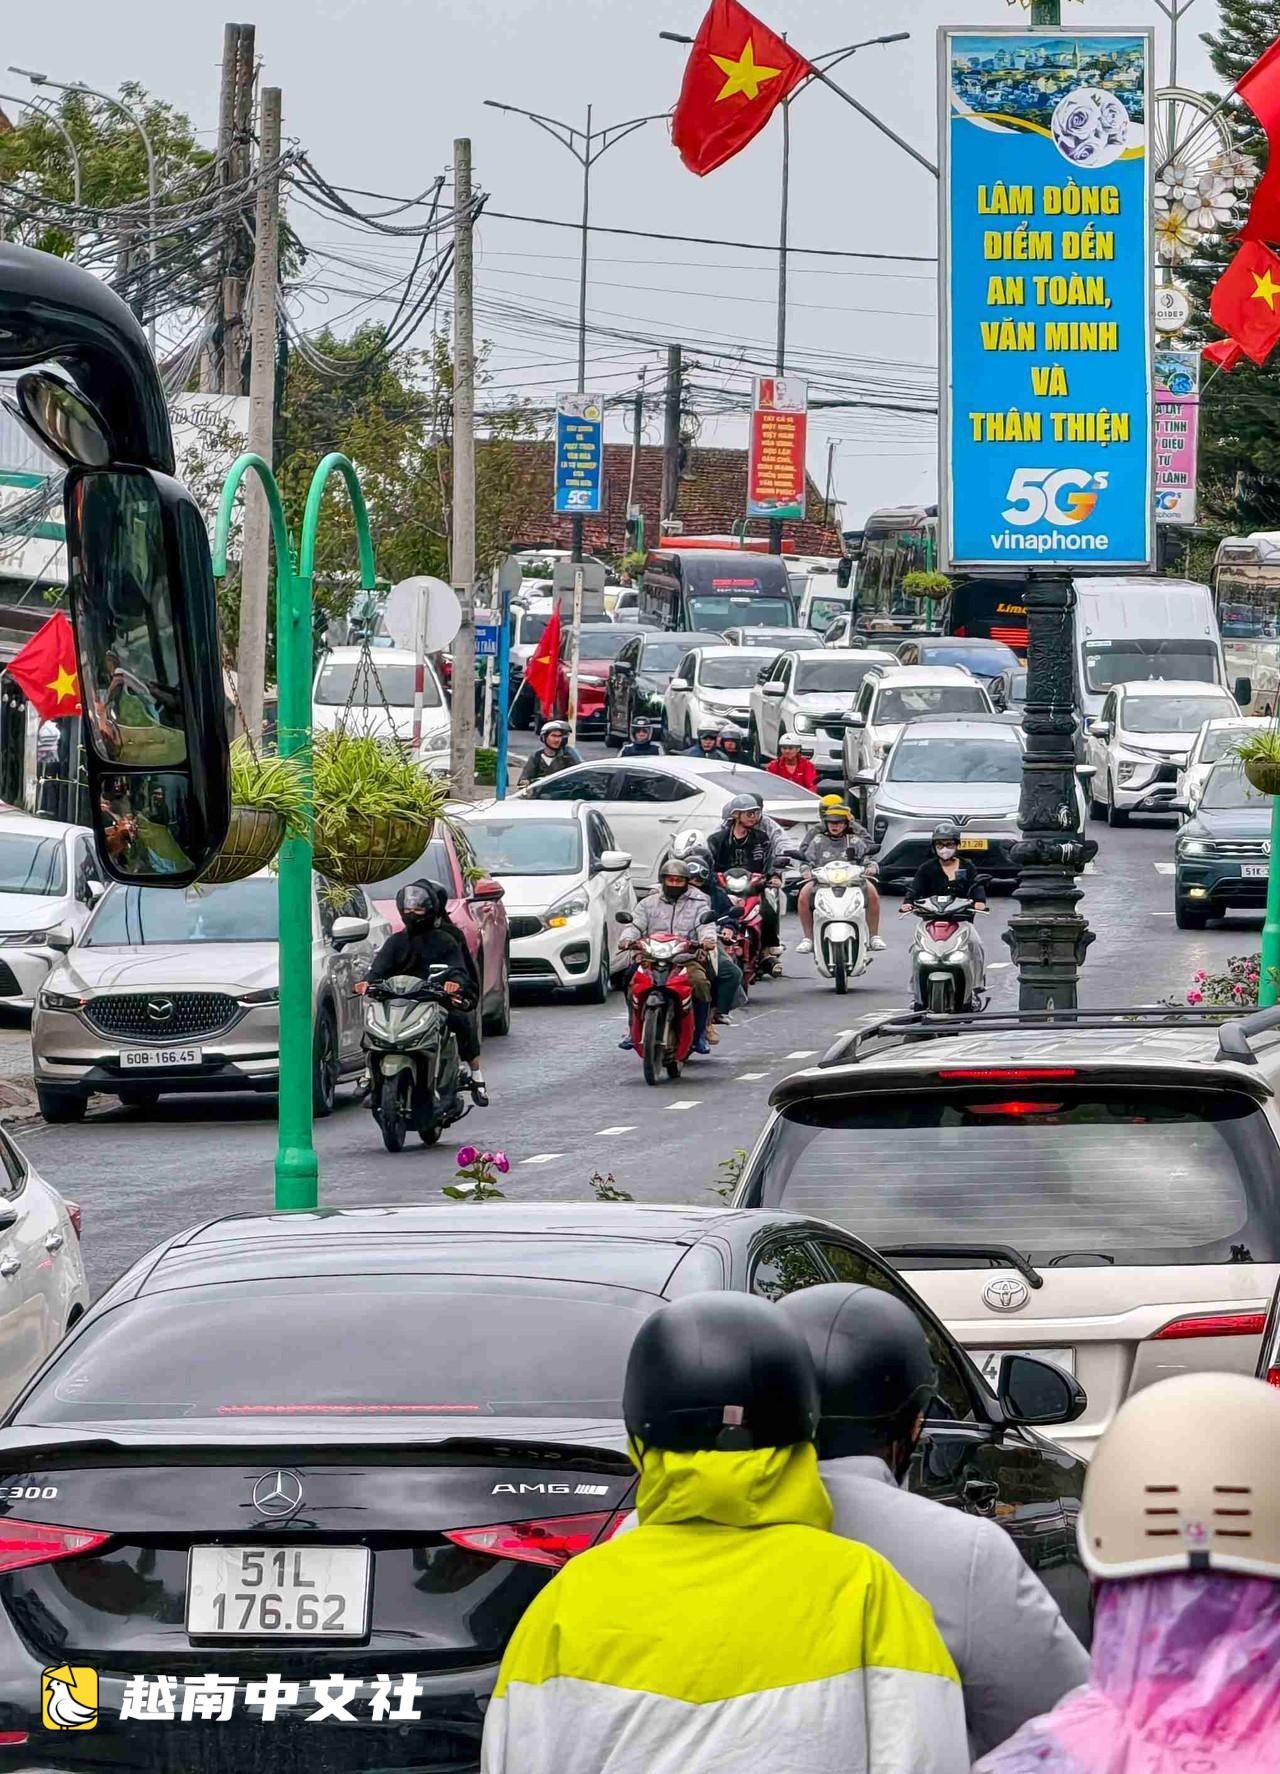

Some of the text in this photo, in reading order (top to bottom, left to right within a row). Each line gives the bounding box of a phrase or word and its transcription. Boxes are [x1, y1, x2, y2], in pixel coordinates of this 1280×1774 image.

[978, 176, 1120, 215] LÂM ĐỒNG
[1062, 222, 1115, 260] ĐẾN
[987, 272, 1112, 309] AN TOÀN,
[980, 317, 1118, 351] VĂN MINH
[1031, 363, 1068, 397] VÀ
[969, 407, 1130, 447] THÂN THIỆN
[991, 530, 1109, 553] vinaphone
[491, 1483, 570, 1495] AMG
[241, 1550, 316, 1588] 51L
[212, 1592, 346, 1631] 176.62
